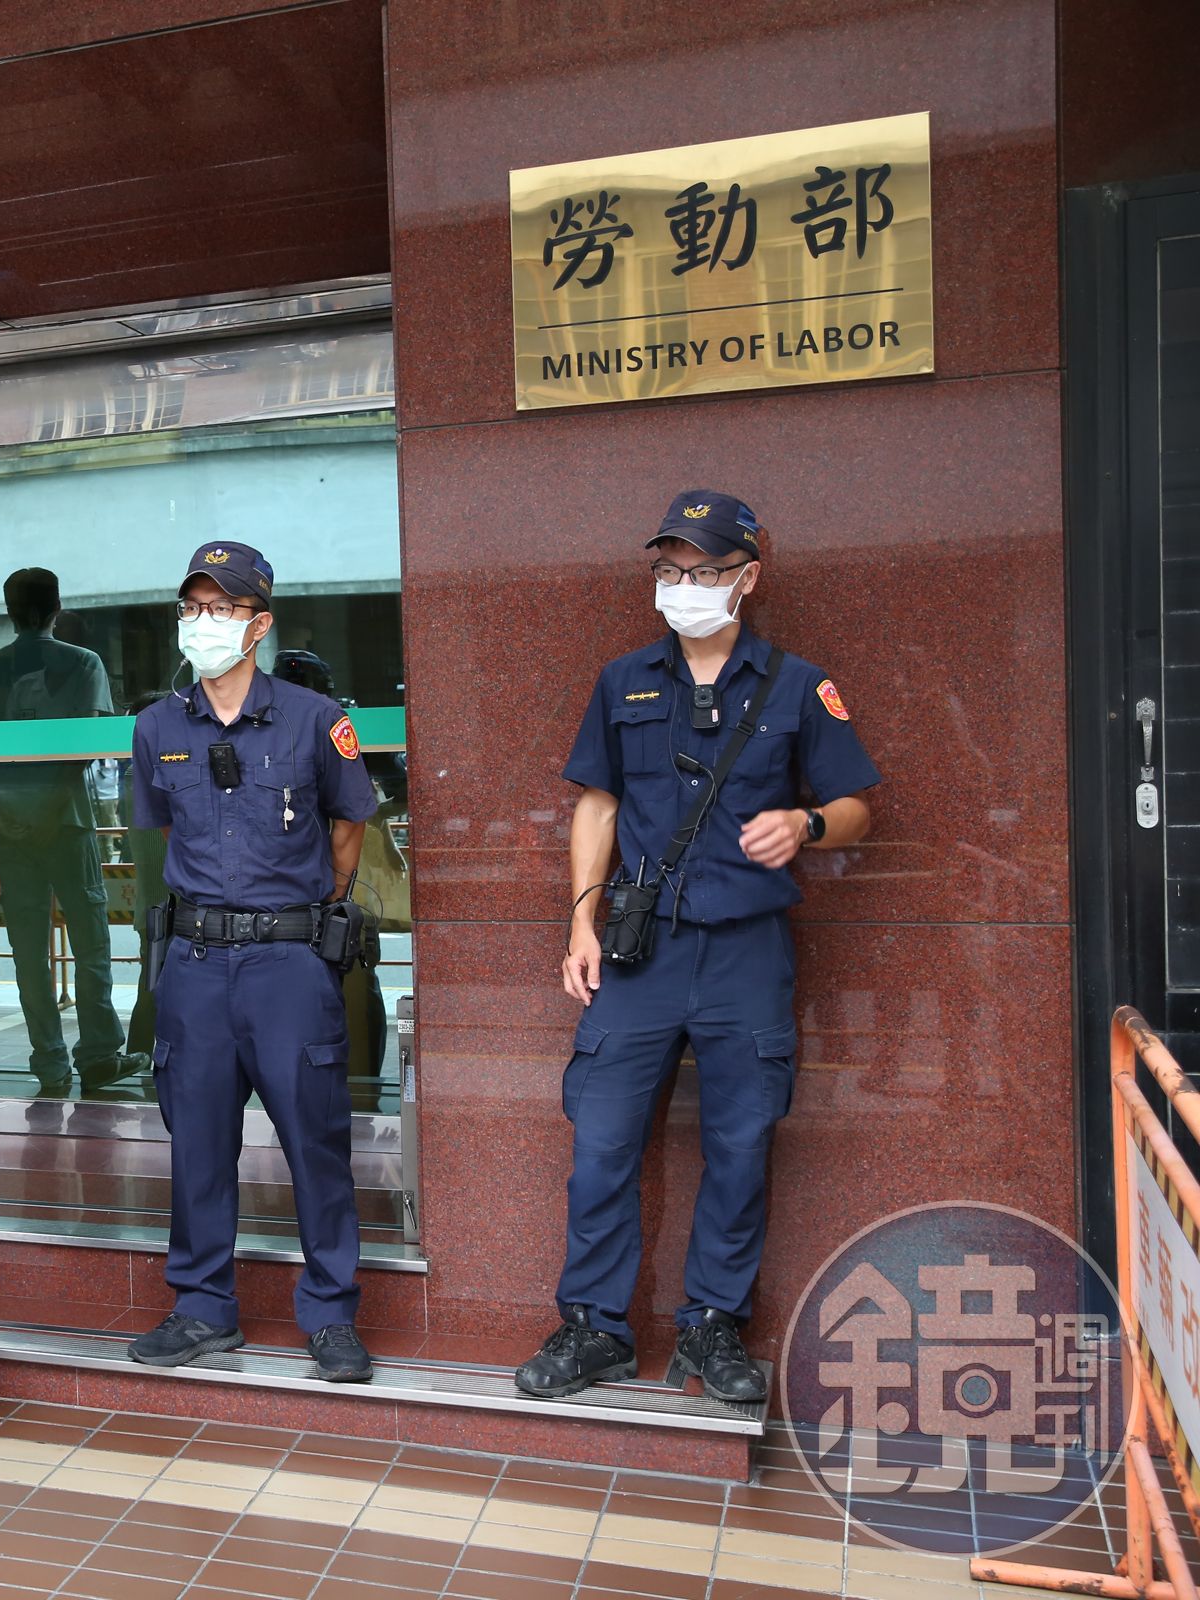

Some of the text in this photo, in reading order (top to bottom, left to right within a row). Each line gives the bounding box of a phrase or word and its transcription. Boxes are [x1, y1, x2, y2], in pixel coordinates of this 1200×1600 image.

[543, 163, 895, 291] 勞動部
[542, 320, 901, 380] MINISTRY OF LABOR
